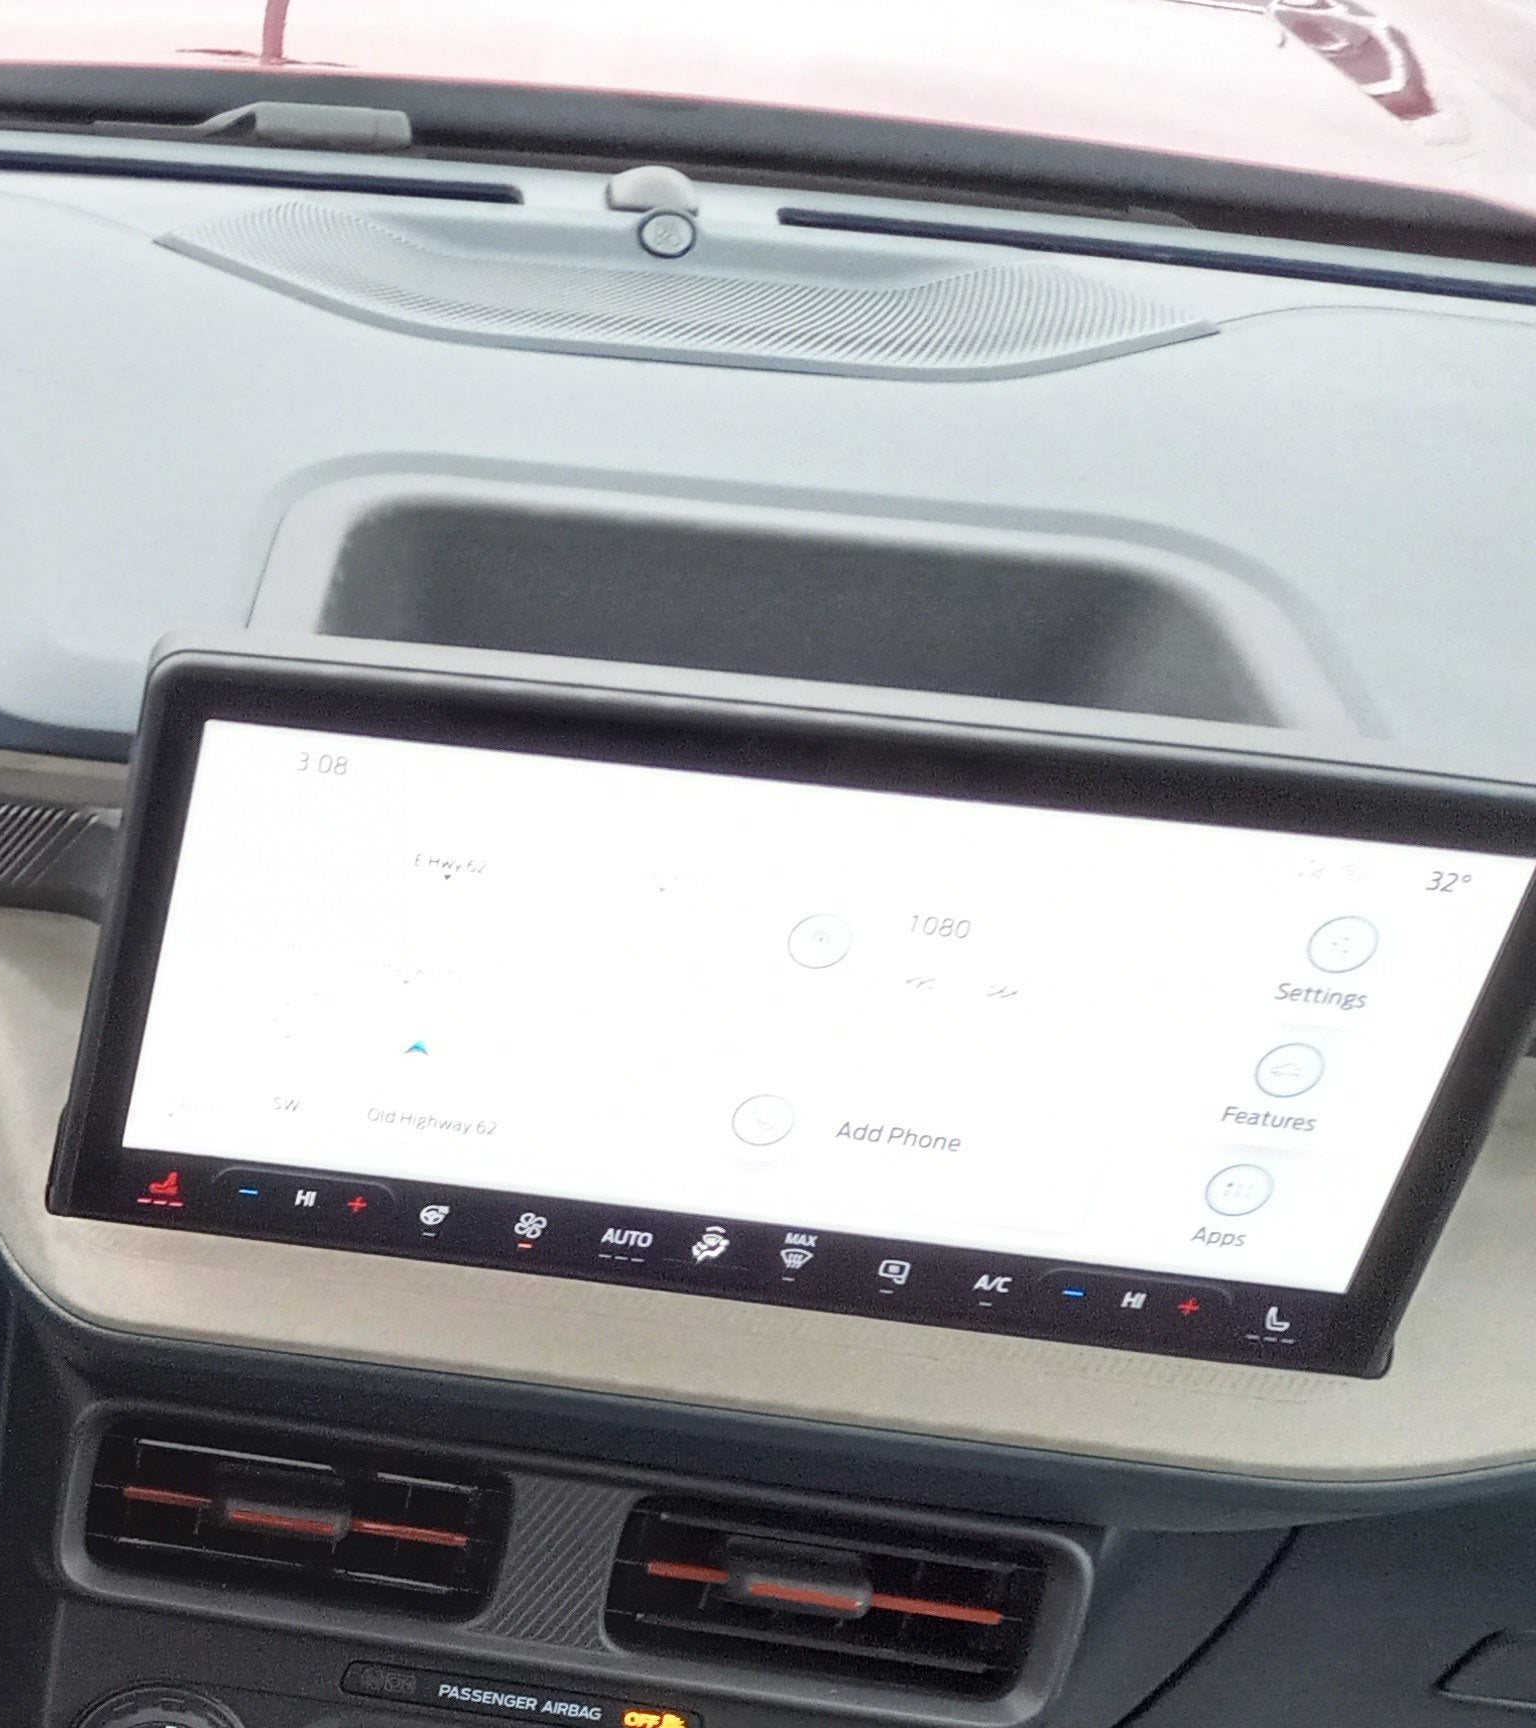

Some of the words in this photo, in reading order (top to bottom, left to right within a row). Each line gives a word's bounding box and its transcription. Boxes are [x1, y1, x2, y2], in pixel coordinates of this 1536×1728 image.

[907, 914, 972, 941] 1080
[1274, 982, 1369, 1011] Settings
[366, 1106, 397, 1125] Old
[399, 1111, 473, 1135] Highway
[475, 1119, 498, 1136] 62
[1220, 1104, 1317, 1133] Features
[835, 1120, 883, 1145] Add
[886, 1124, 963, 1154] Phone
[294, 1189, 318, 1208] HI
[600, 1227, 654, 1249] AUTO
[784, 1232, 819, 1248] MAX
[1191, 1226, 1248, 1249] Apps
[972, 1273, 1013, 1294] A/C
[438, 1683, 538, 1712] PASSENGER
[541, 1700, 604, 1722] AIRBAG
